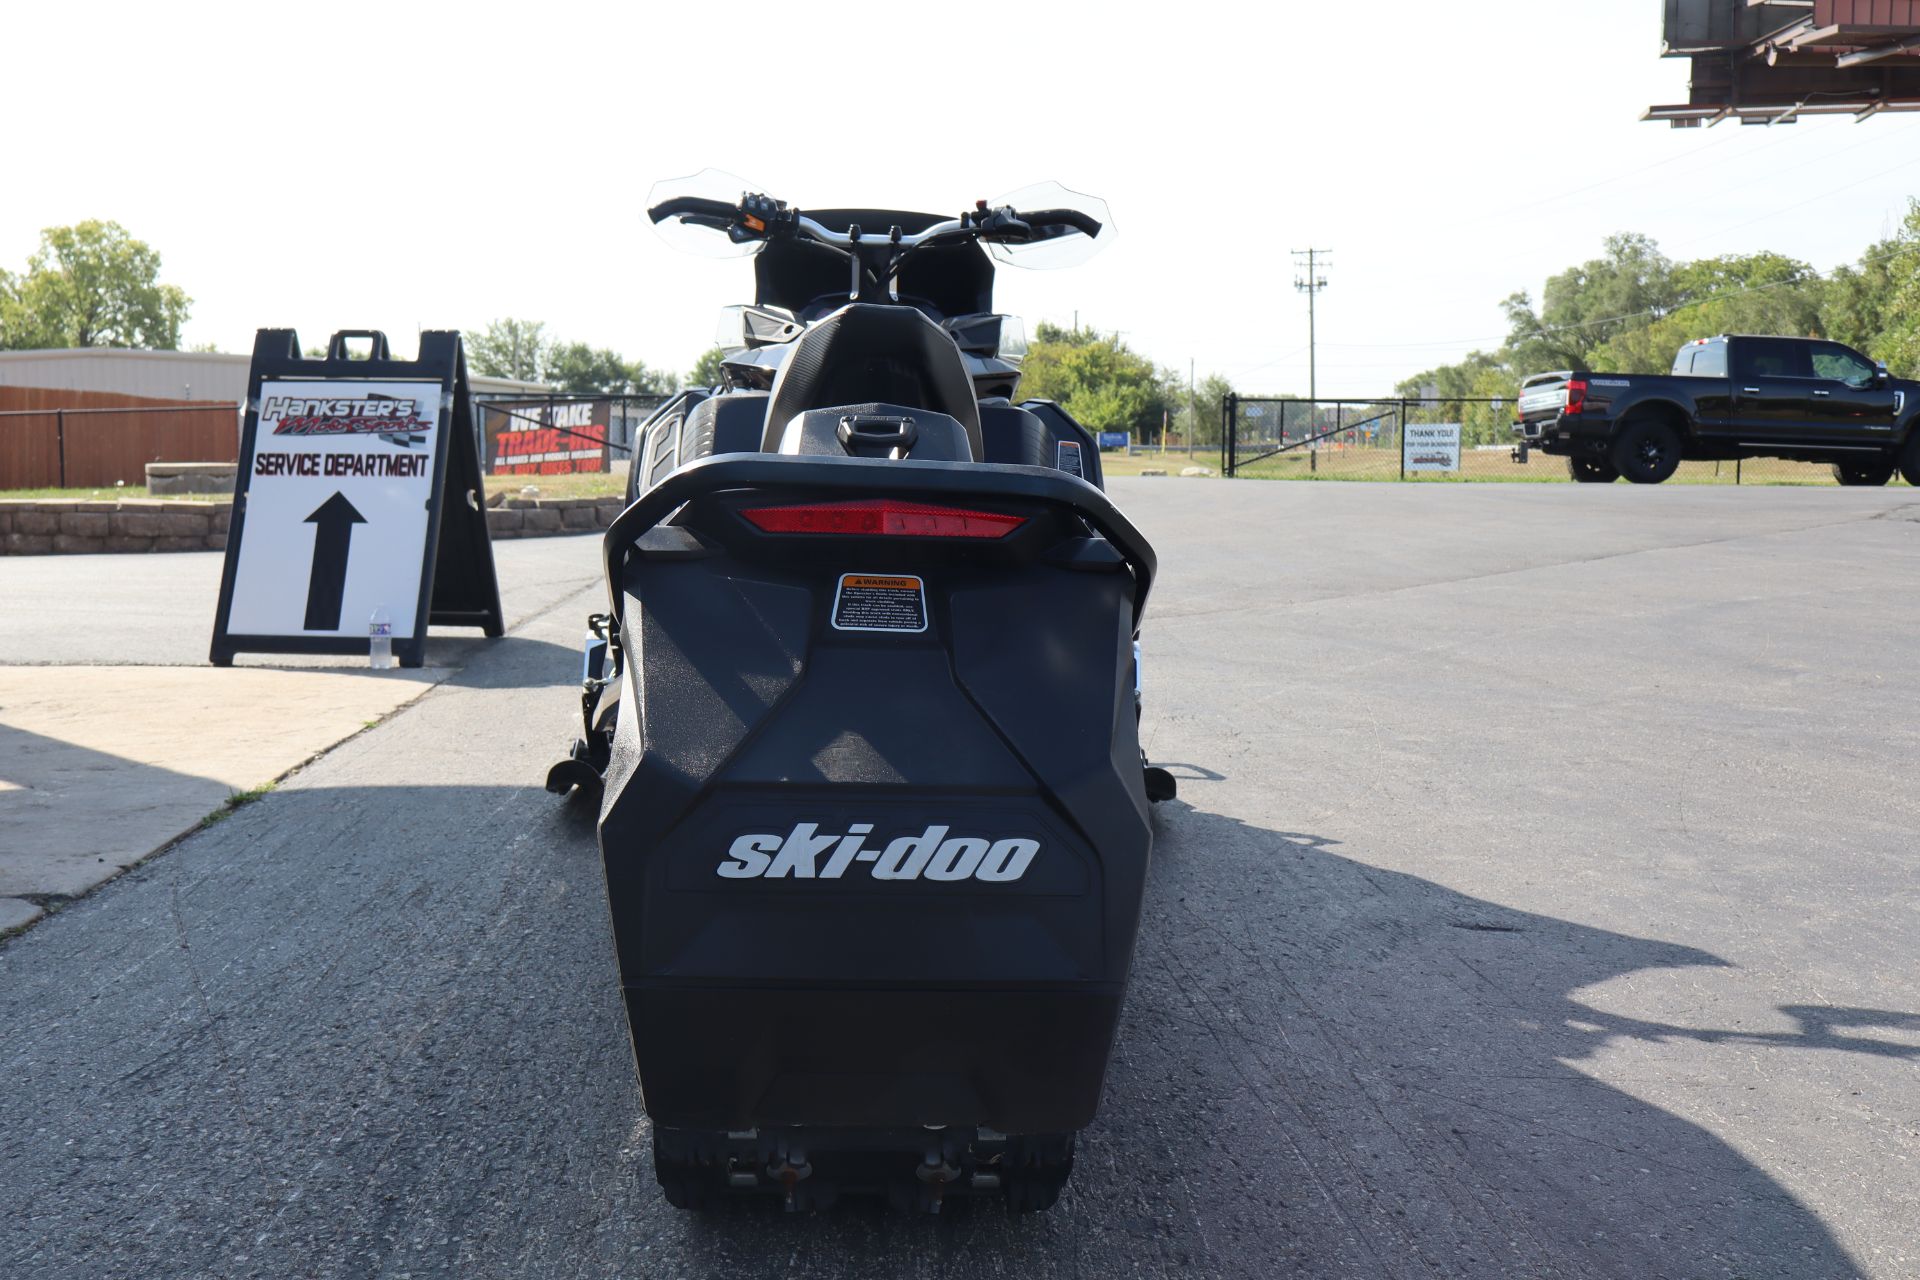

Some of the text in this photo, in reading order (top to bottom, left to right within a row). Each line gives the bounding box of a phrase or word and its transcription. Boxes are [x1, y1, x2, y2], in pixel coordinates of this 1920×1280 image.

[510, 403, 594, 432] WE TAKE
[496, 424, 606, 457] TRADE-INS
[255, 453, 429, 477] SERVICE DEPARTMENT
